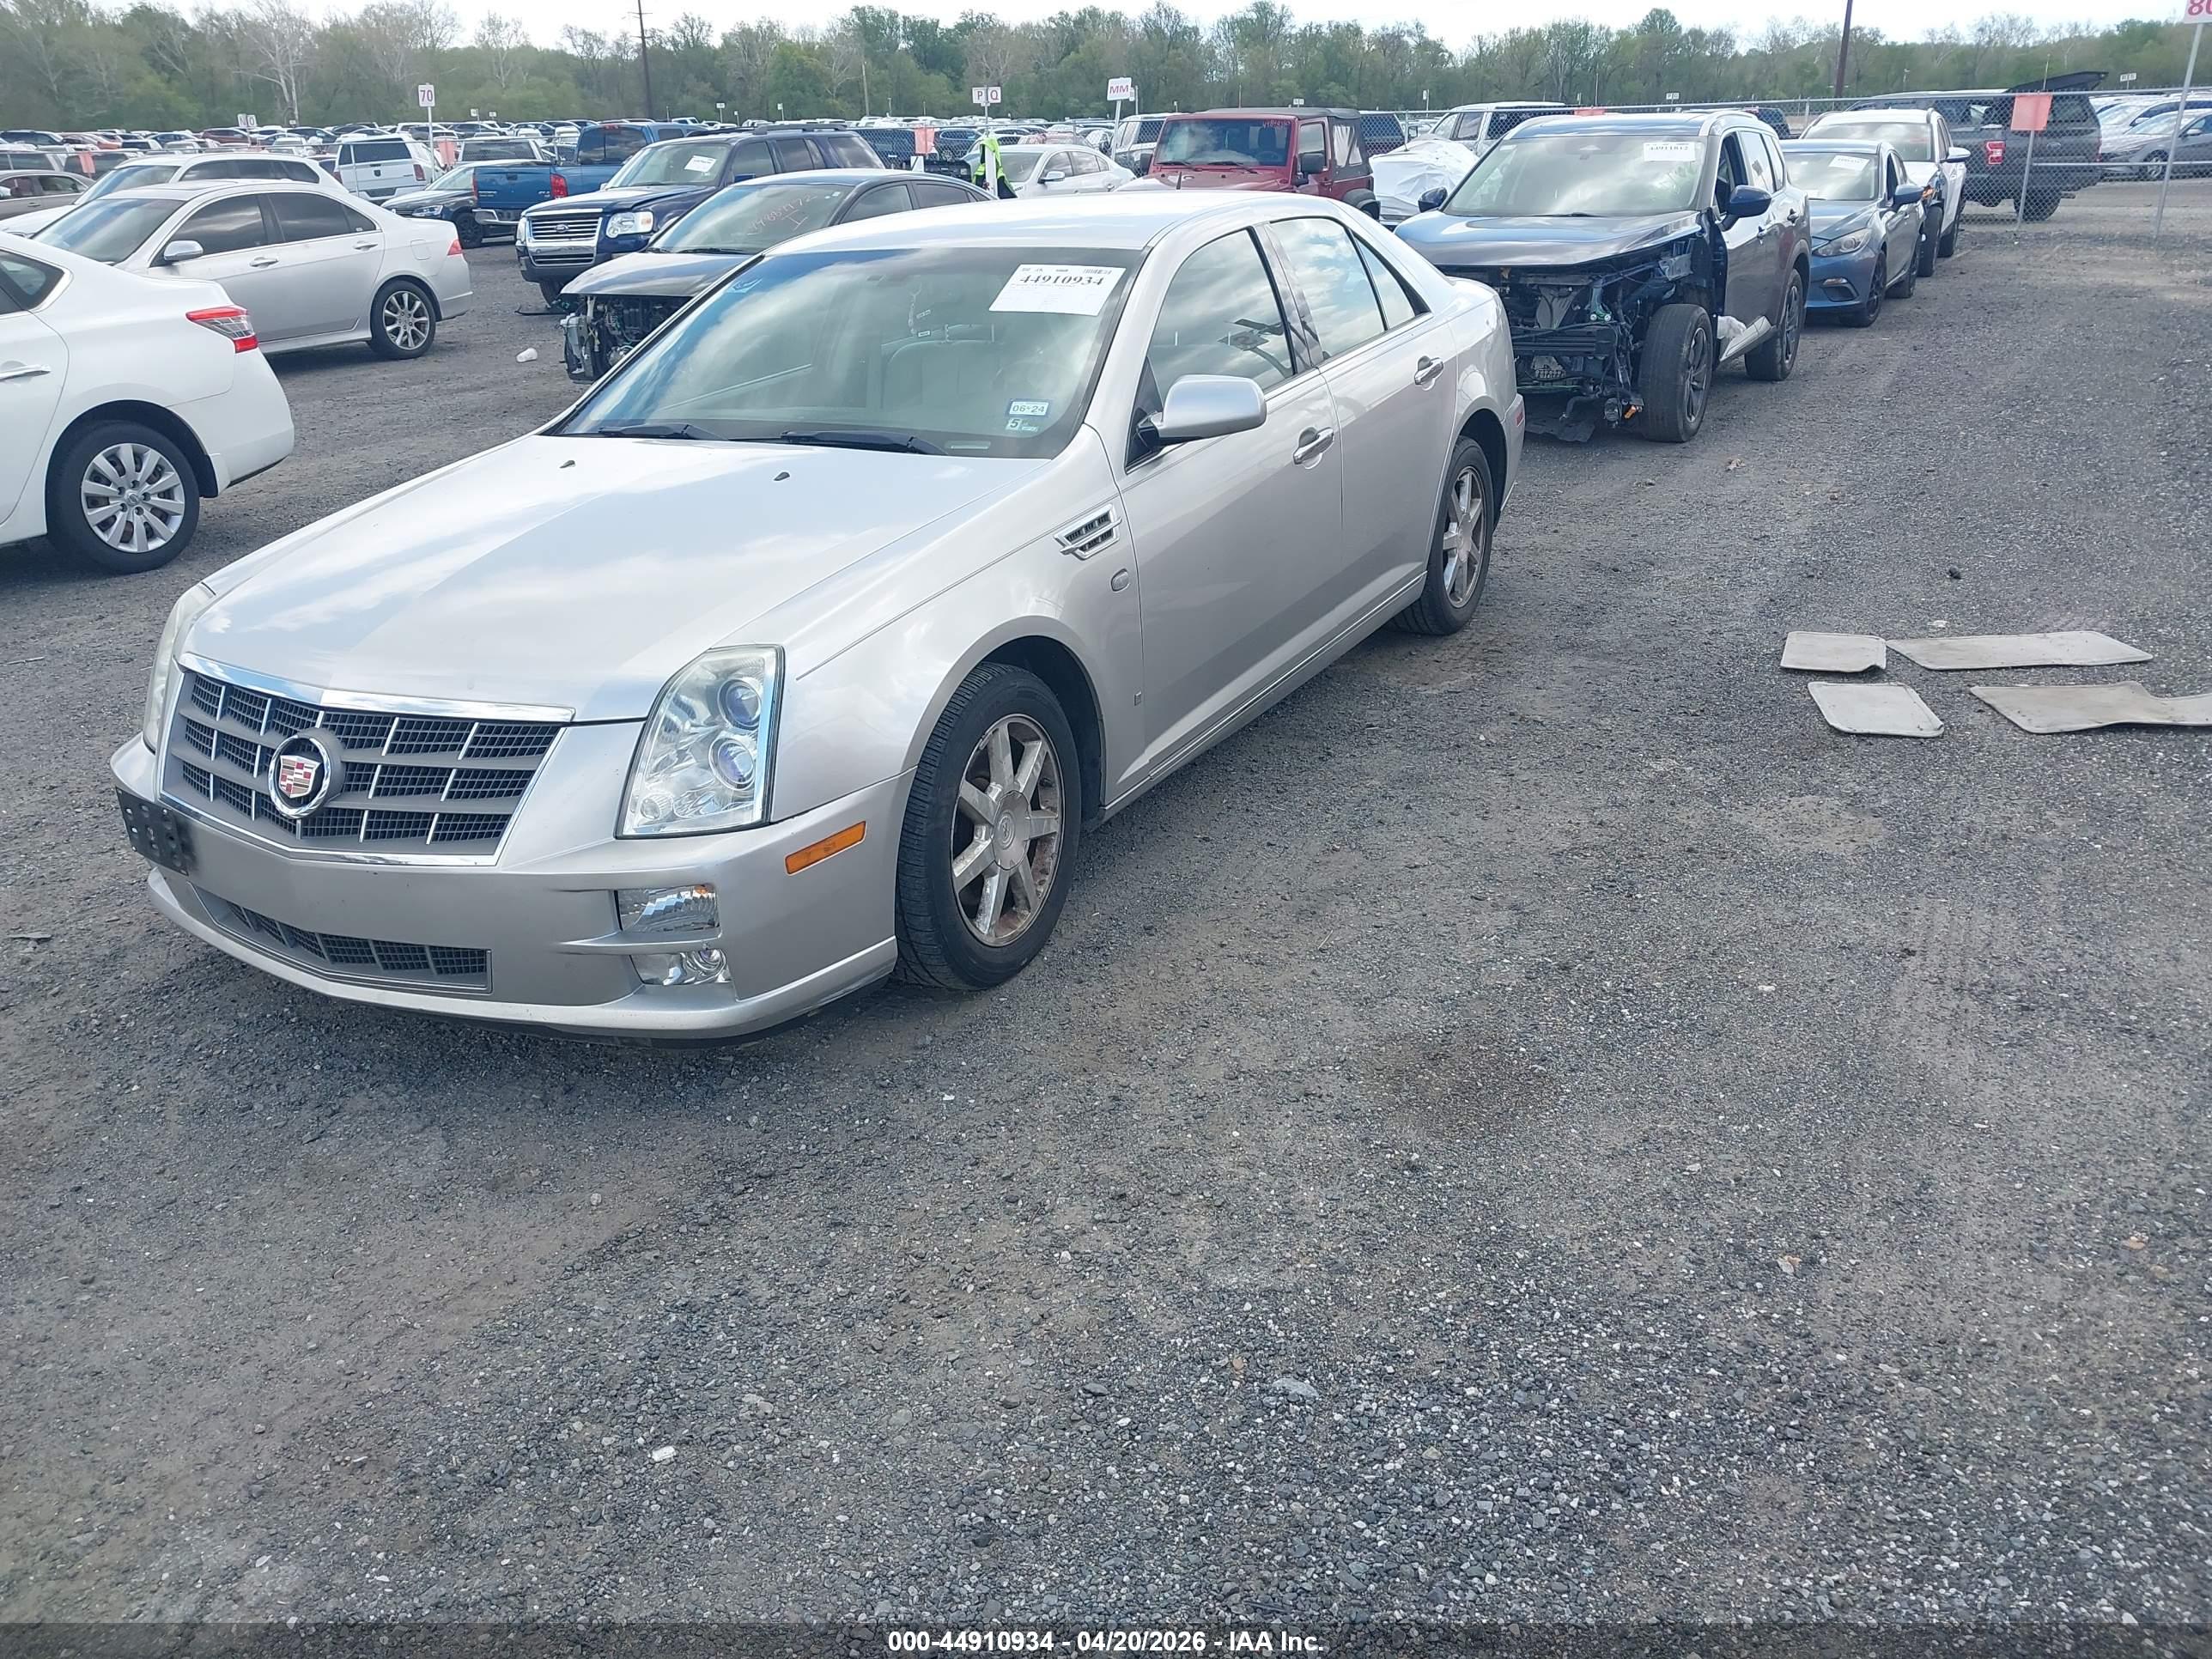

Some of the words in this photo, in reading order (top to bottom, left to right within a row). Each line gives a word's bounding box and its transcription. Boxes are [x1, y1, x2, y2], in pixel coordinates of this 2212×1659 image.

[990, 89, 999, 100] Q
[1109, 84, 1129, 94] MM
[420, 89, 434, 102] 70
[977, 90, 983, 100] P
[1019, 274, 1104, 286] 44910934
